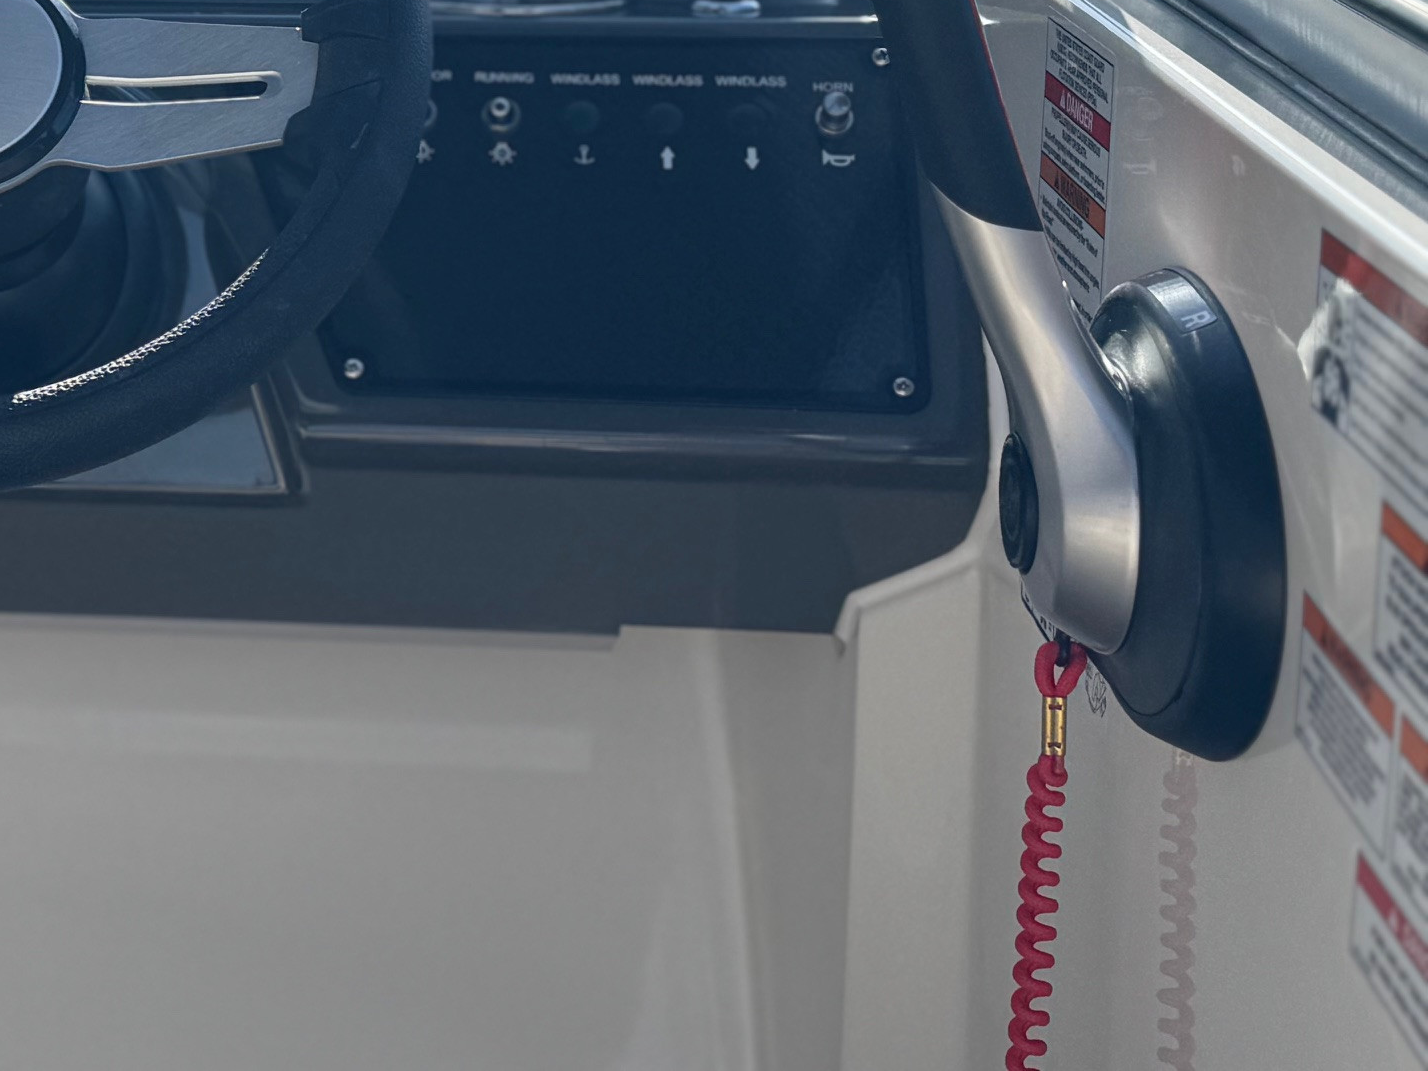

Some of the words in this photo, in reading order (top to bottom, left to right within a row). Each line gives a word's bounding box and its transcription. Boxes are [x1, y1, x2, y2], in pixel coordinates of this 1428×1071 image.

[474, 70, 535, 84] RUNNING
[550, 73, 620, 86] WINDLASS
[632, 74, 704, 87] WINDLASS
[715, 75, 787, 88] WINDLASS
[813, 81, 853, 93] HORN
[1066, 92, 1094, 133] DANGER
[1180, 310, 1211, 328] R
